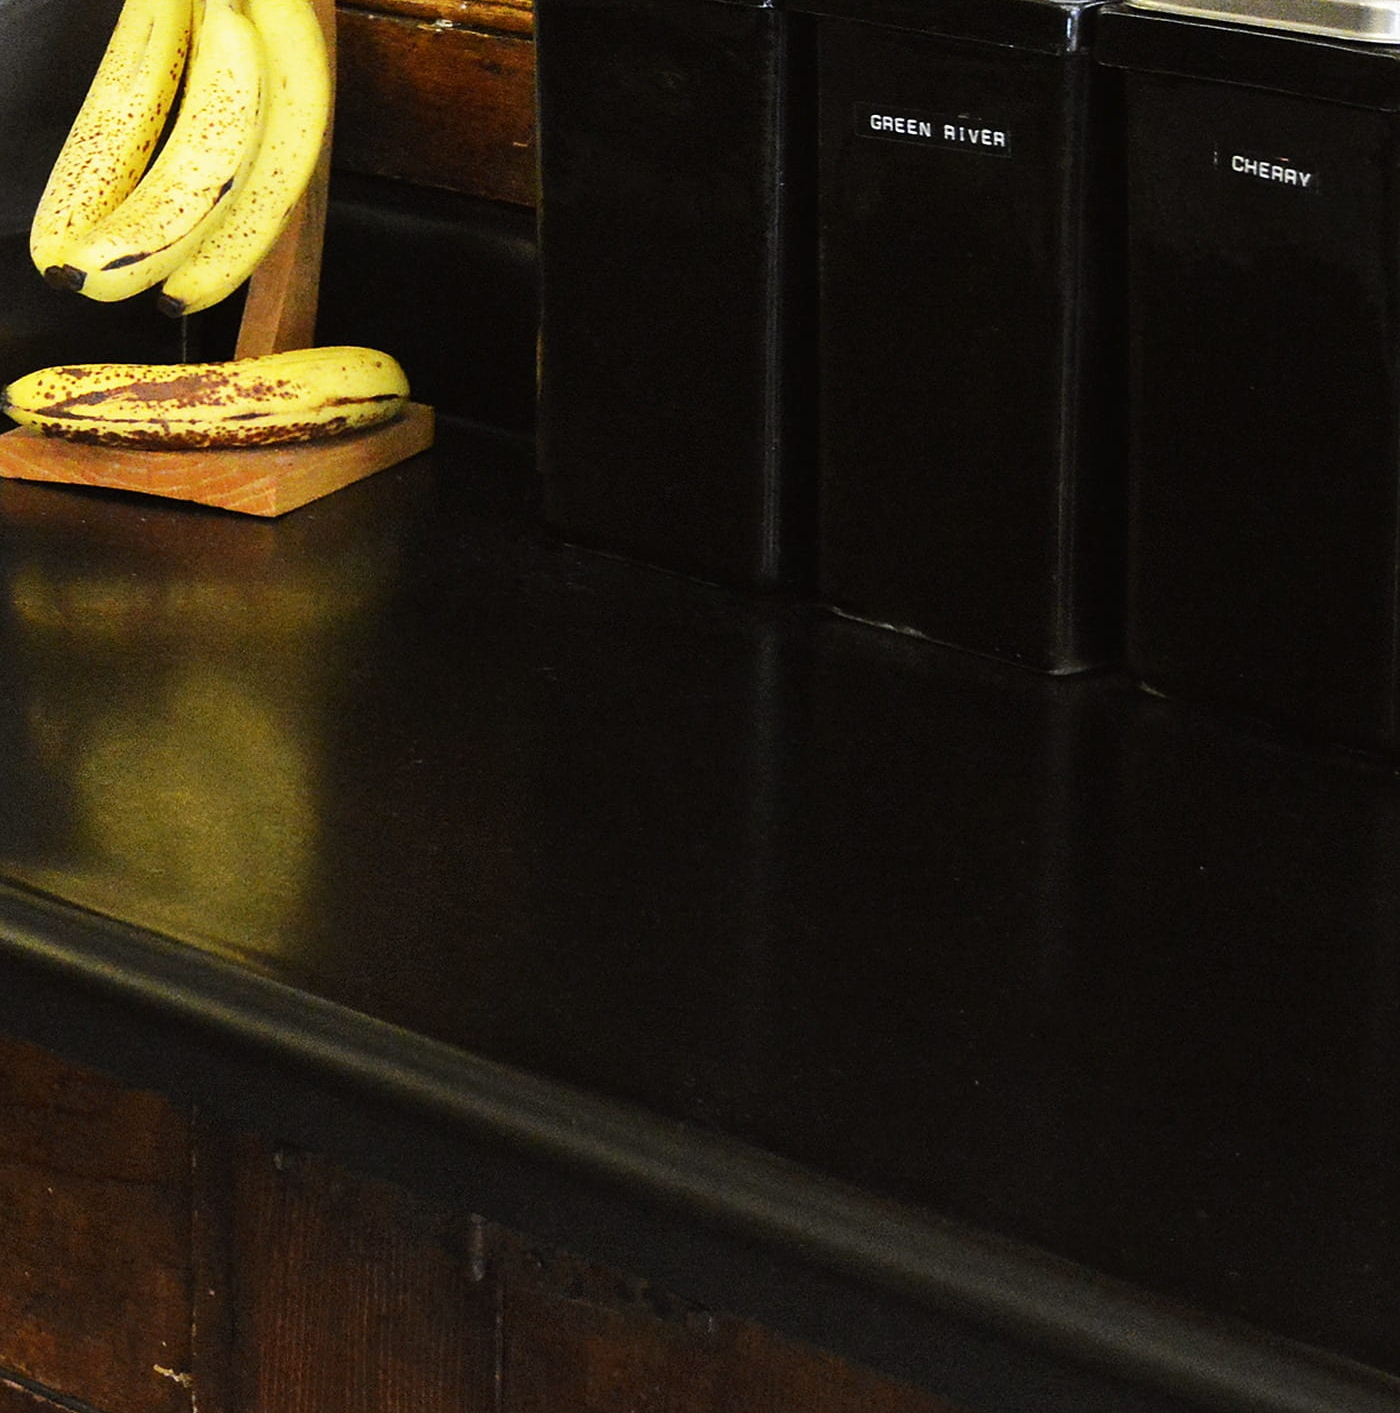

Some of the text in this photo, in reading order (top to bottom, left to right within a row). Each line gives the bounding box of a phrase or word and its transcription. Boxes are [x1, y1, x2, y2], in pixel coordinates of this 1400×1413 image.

[869, 113, 1006, 148] GREEN RIVER
[1231, 155, 1312, 188] CHERRY
